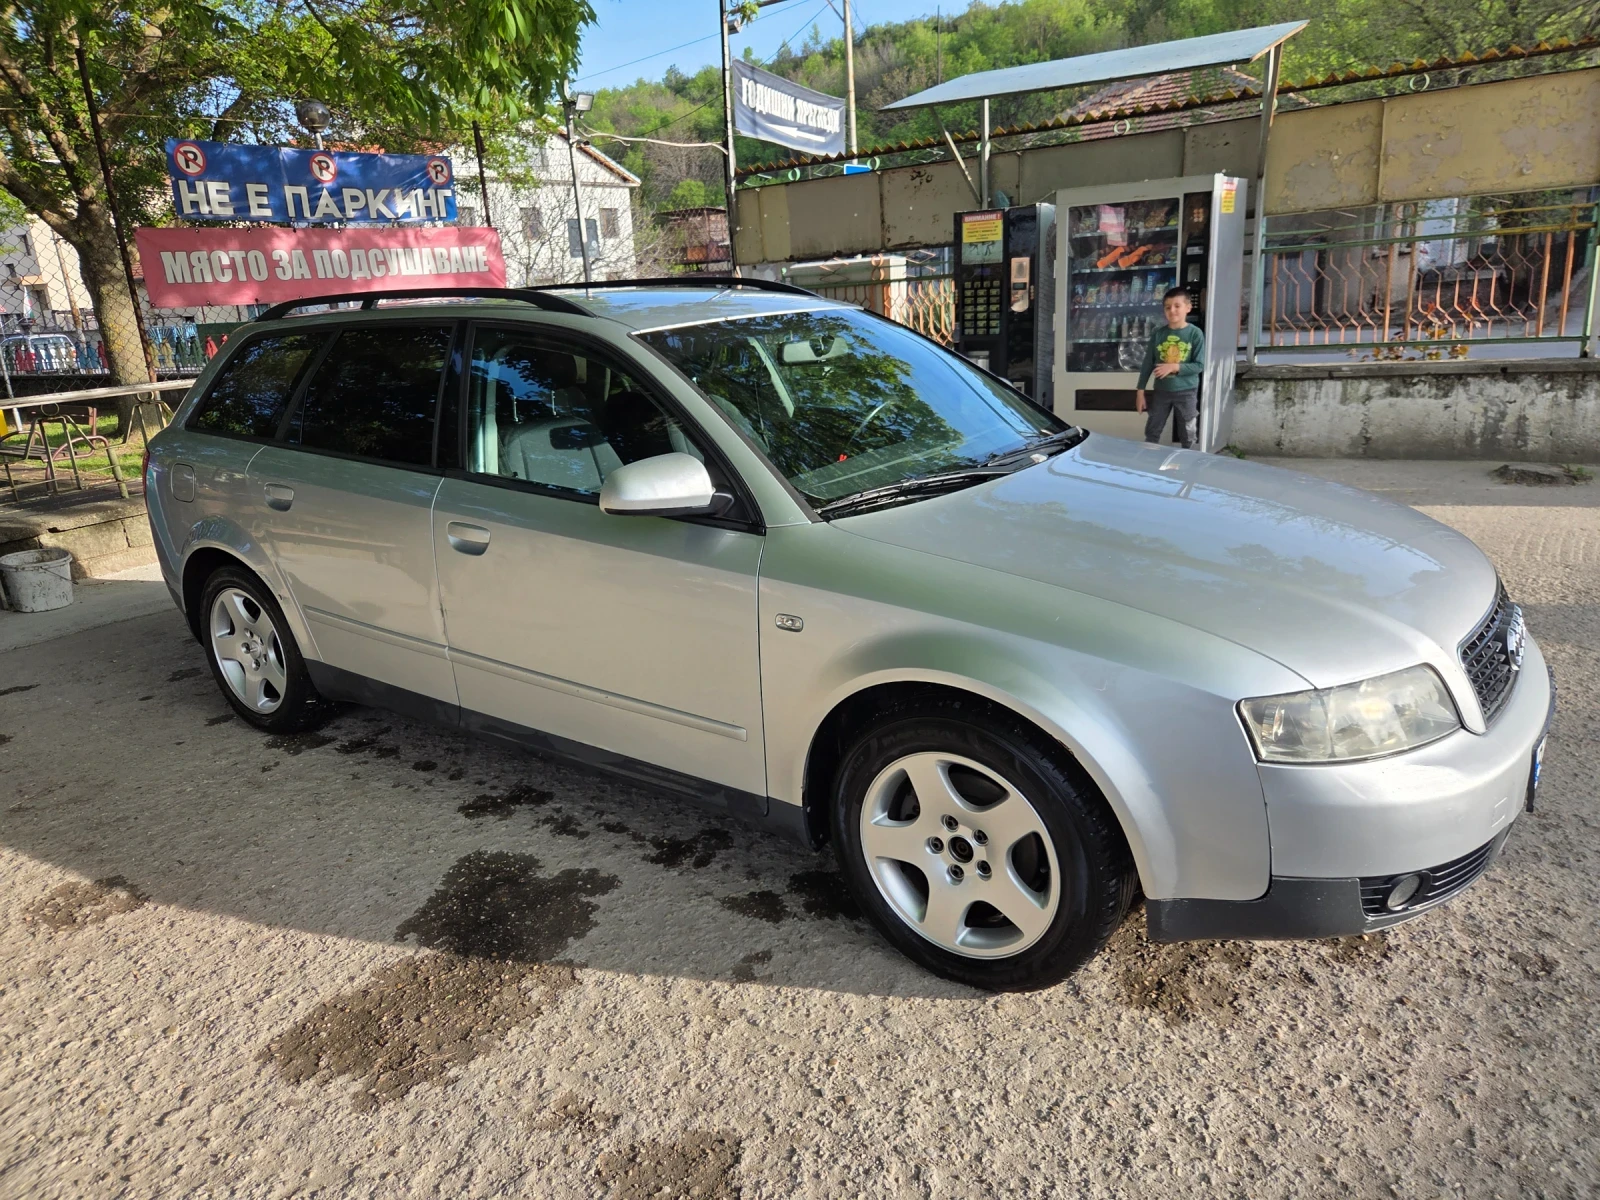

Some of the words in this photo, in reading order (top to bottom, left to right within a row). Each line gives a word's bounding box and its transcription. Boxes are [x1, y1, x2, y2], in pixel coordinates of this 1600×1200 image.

[741, 77, 795, 122] ГОДИШНИ
[177, 180, 234, 216] НЕ
[246, 183, 272, 217] Е
[284, 184, 453, 219] ПАРКИНГ
[159, 249, 268, 284] МЯСТО
[275, 249, 311, 280] ЗА
[312, 246, 489, 281] ПОДСУШАВАНЕ
